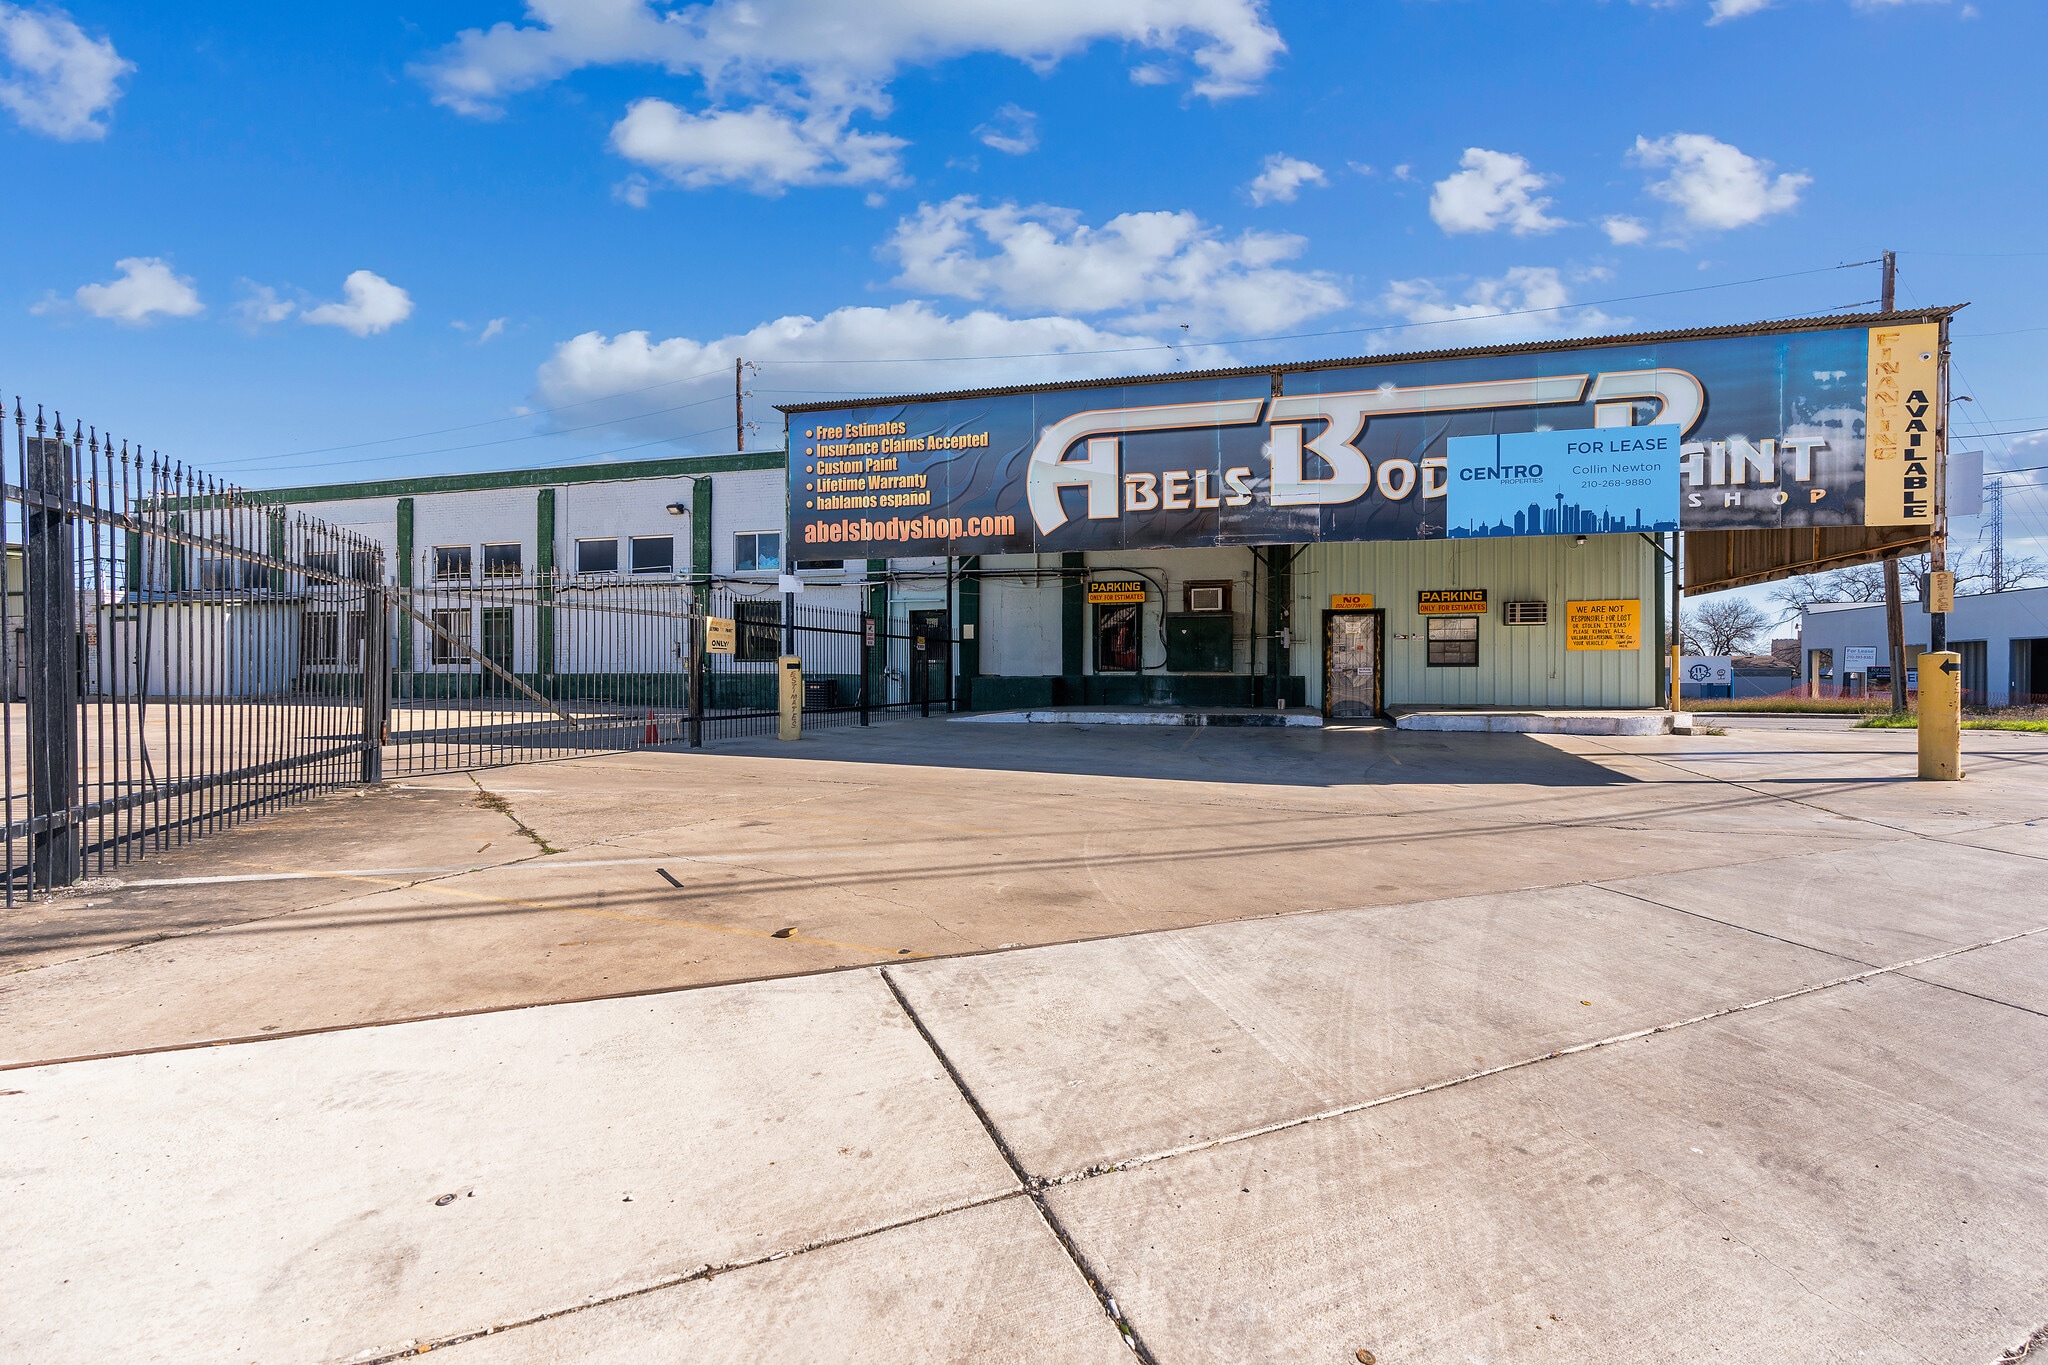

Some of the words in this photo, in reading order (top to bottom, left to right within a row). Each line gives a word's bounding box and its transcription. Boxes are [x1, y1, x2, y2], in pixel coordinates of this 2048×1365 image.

[816, 425, 842, 440] Free
[845, 422, 906, 438] Estimates
[816, 441, 878, 458] Insurance
[881, 438, 925, 453] Claims
[927, 432, 989, 450] Accepted
[1567, 442, 1603, 454] FOR
[1610, 438, 1668, 453] LEASE
[1904, 390, 1929, 518] AVAILABLE
[816, 461, 863, 475] Custom
[865, 457, 898, 472] Paint
[1026, 398, 1264, 536] ABELS
[1459, 464, 1543, 481] CENTRO
[1572, 464, 1608, 475] Collin
[1612, 462, 1661, 473] Newton
[816, 477, 866, 493] Lifetime
[867, 473, 927, 490] Warranty
[1500, 477, 1544, 485] PROPERTIES
[1581, 478, 1652, 489] 210-268-9880
[816, 495, 877, 510] hablamos
[879, 490, 931, 507] español
[1688, 489, 1827, 508] SHOP
[804, 515, 1015, 543] abelsbodyshop.com
[1091, 582, 1141, 592] PARKING
[1421, 591, 1483, 602] PARKING
[1451, 603, 1486, 611] ESTIMATES
[1576, 605, 1588, 613] WE
[1590, 605, 1606, 613] ARE
[1570, 614, 1604, 622] RESPONSIBLE
[1605, 614, 1616, 622] FOR
[1617, 613, 1632, 621] LOST
[790, 670, 798, 729] ESTIMATES
